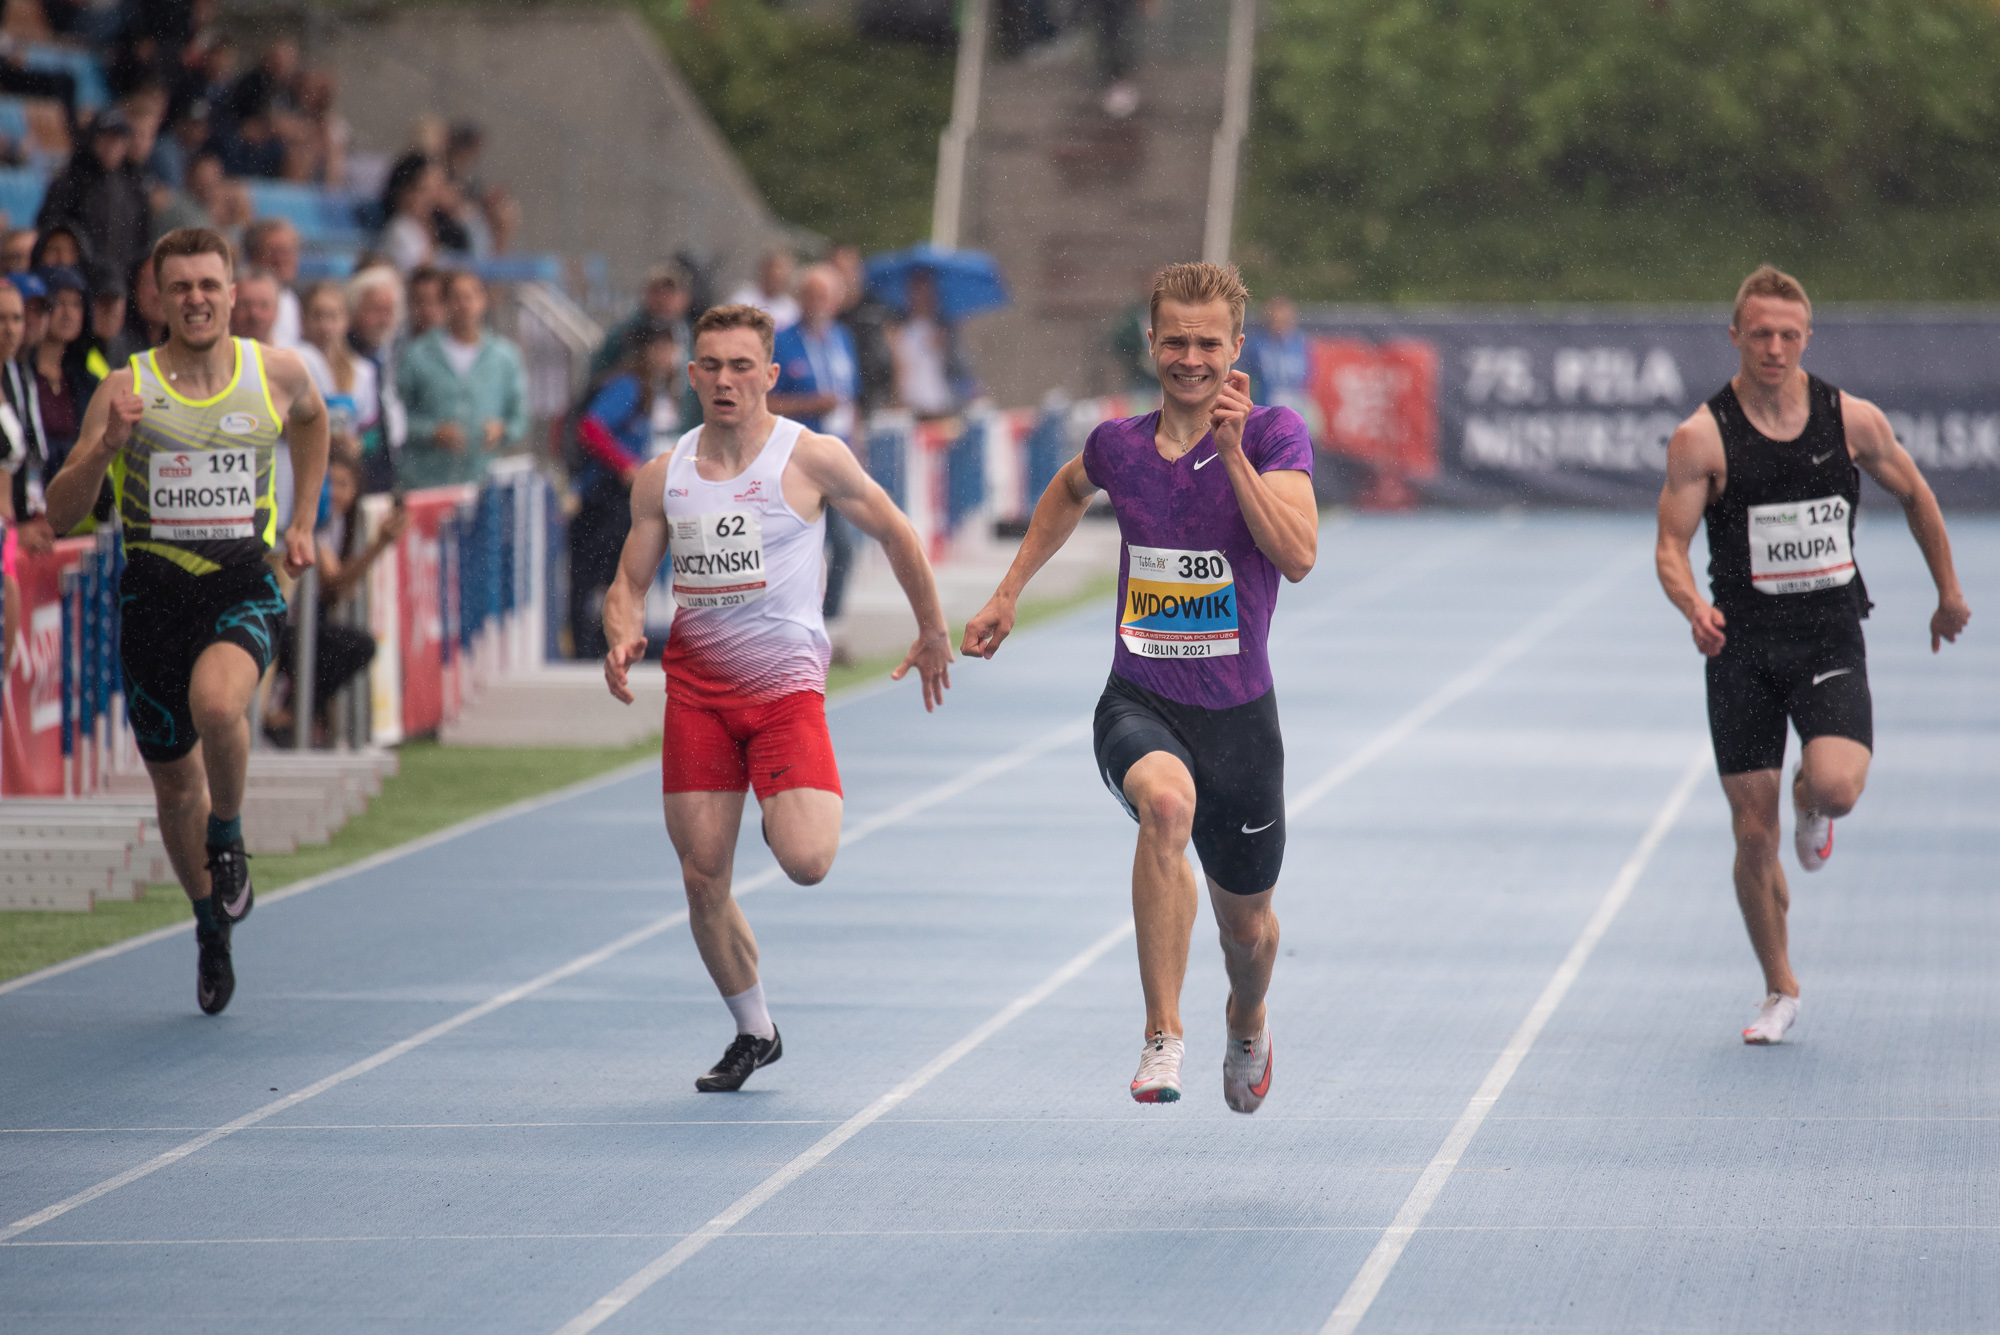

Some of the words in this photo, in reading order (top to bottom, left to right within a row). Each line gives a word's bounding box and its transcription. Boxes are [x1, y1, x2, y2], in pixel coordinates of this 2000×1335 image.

[1464, 411, 1680, 470] MISTRZO
[209, 453, 249, 474] 191
[154, 487, 251, 508] CHROSTA
[1807, 502, 1844, 525] 126
[173, 528, 208, 539] LUBLIN
[715, 515, 746, 538] 62
[1768, 537, 1837, 562] KRUPA
[1178, 555, 1224, 579] 380
[1776, 581, 1811, 594] LUBLIN
[688, 597, 718, 608] LUBLIN
[720, 594, 746, 606] 2021
[1131, 590, 1232, 619] WDOWIK
[1141, 642, 1178, 656] LUBLIN
[1182, 644, 1211, 656] 2021
